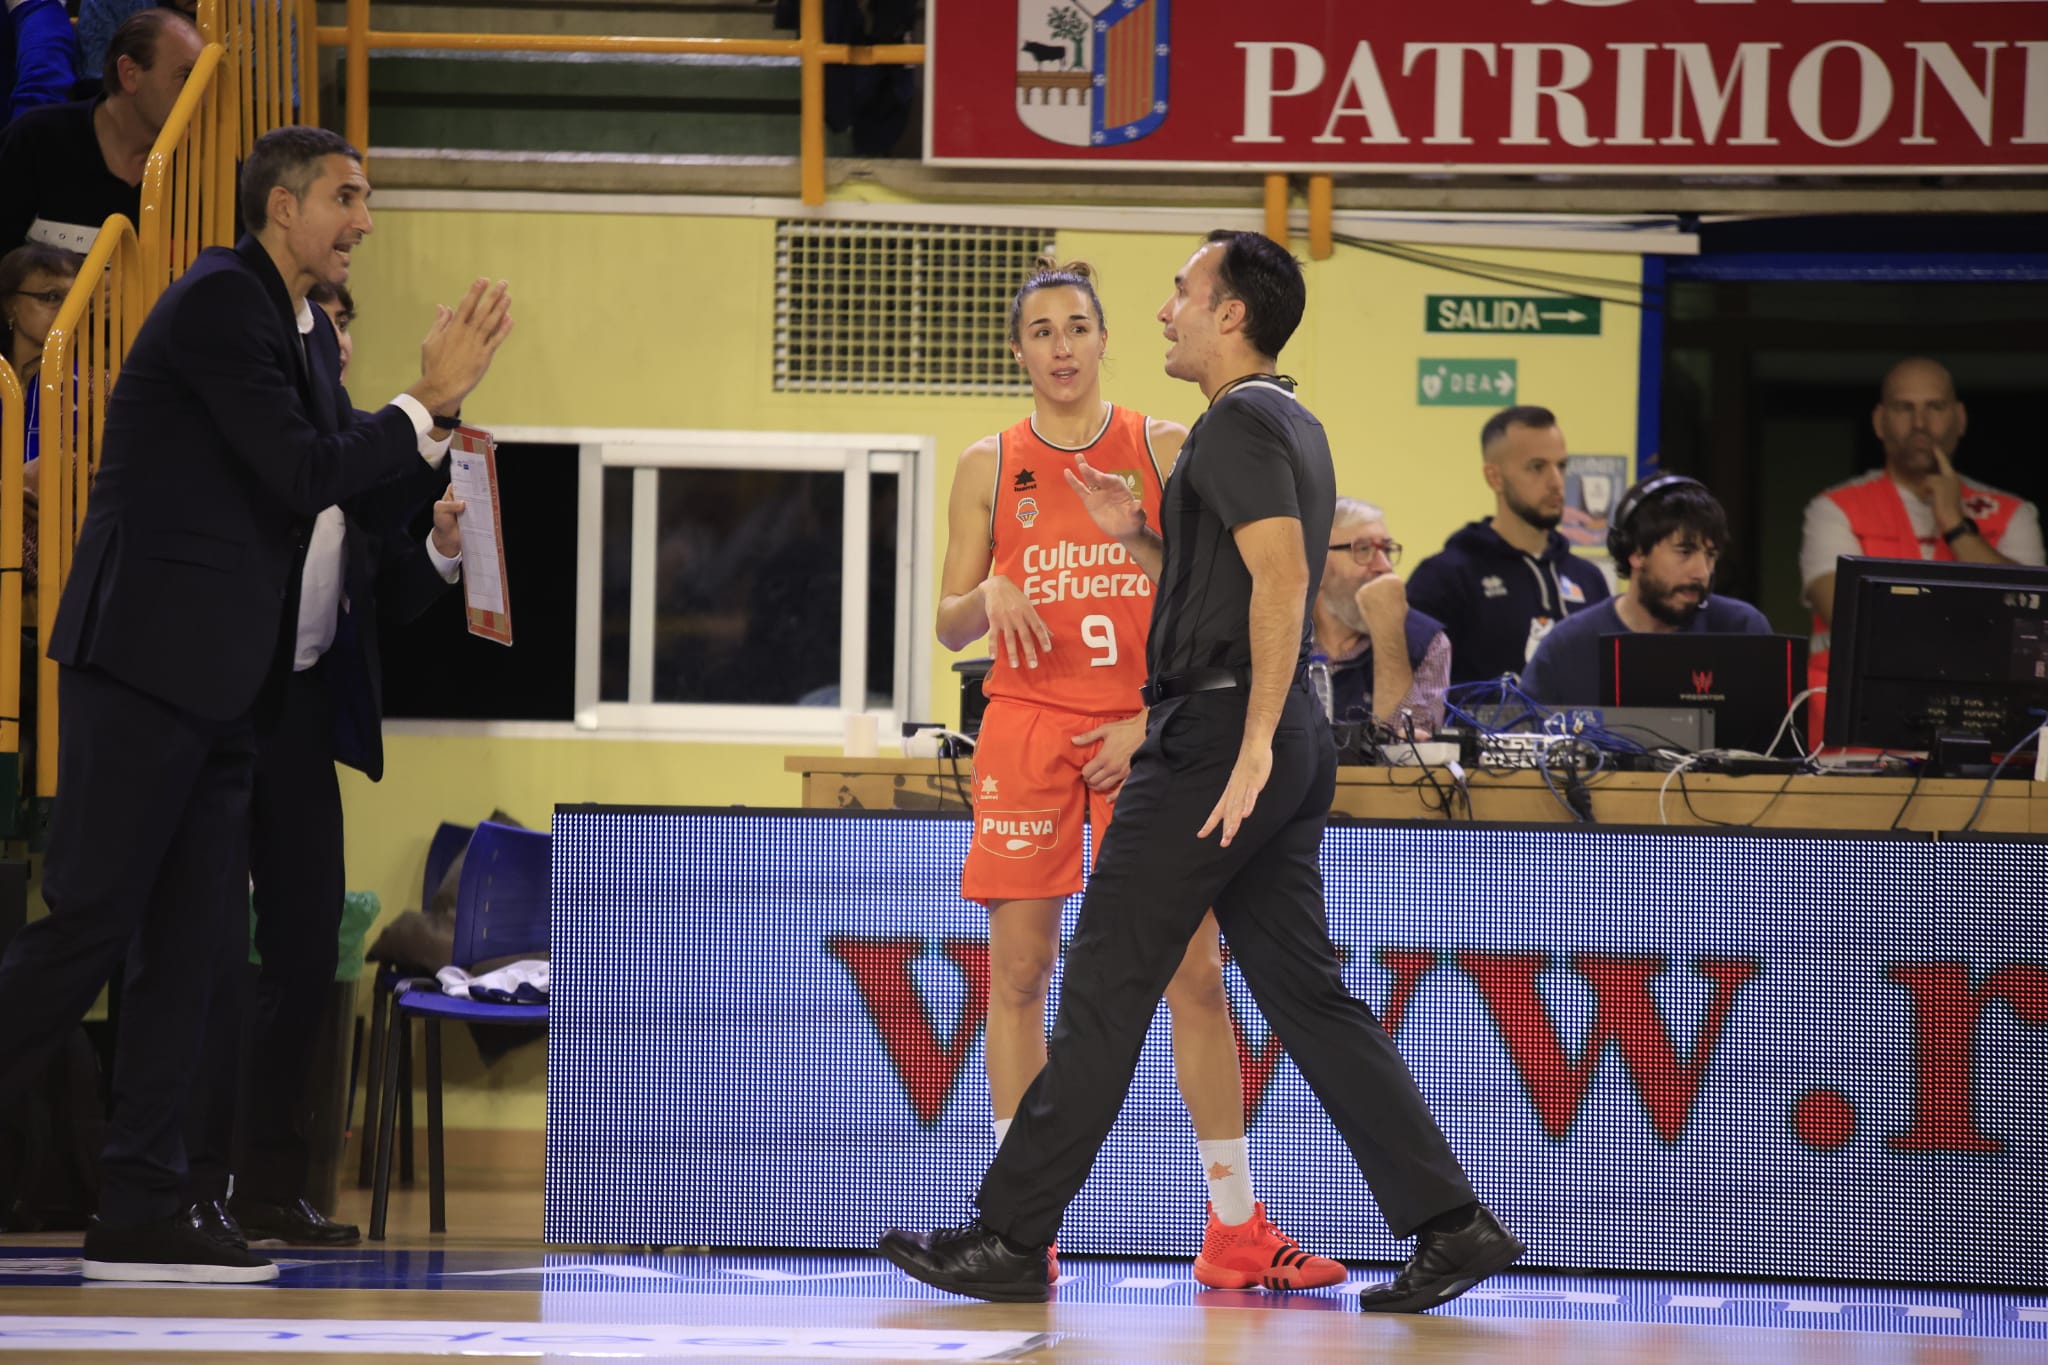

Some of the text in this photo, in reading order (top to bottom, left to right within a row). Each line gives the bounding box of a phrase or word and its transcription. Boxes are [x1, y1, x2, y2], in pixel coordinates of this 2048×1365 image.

[1438, 299, 1541, 330] SALIDA
[1450, 372, 1493, 394] DEA
[1023, 540, 1126, 574] Cultura
[1023, 570, 1151, 606] Esfuerzo
[1081, 614, 1118, 667] 9
[981, 818, 1054, 836] PULEVA
